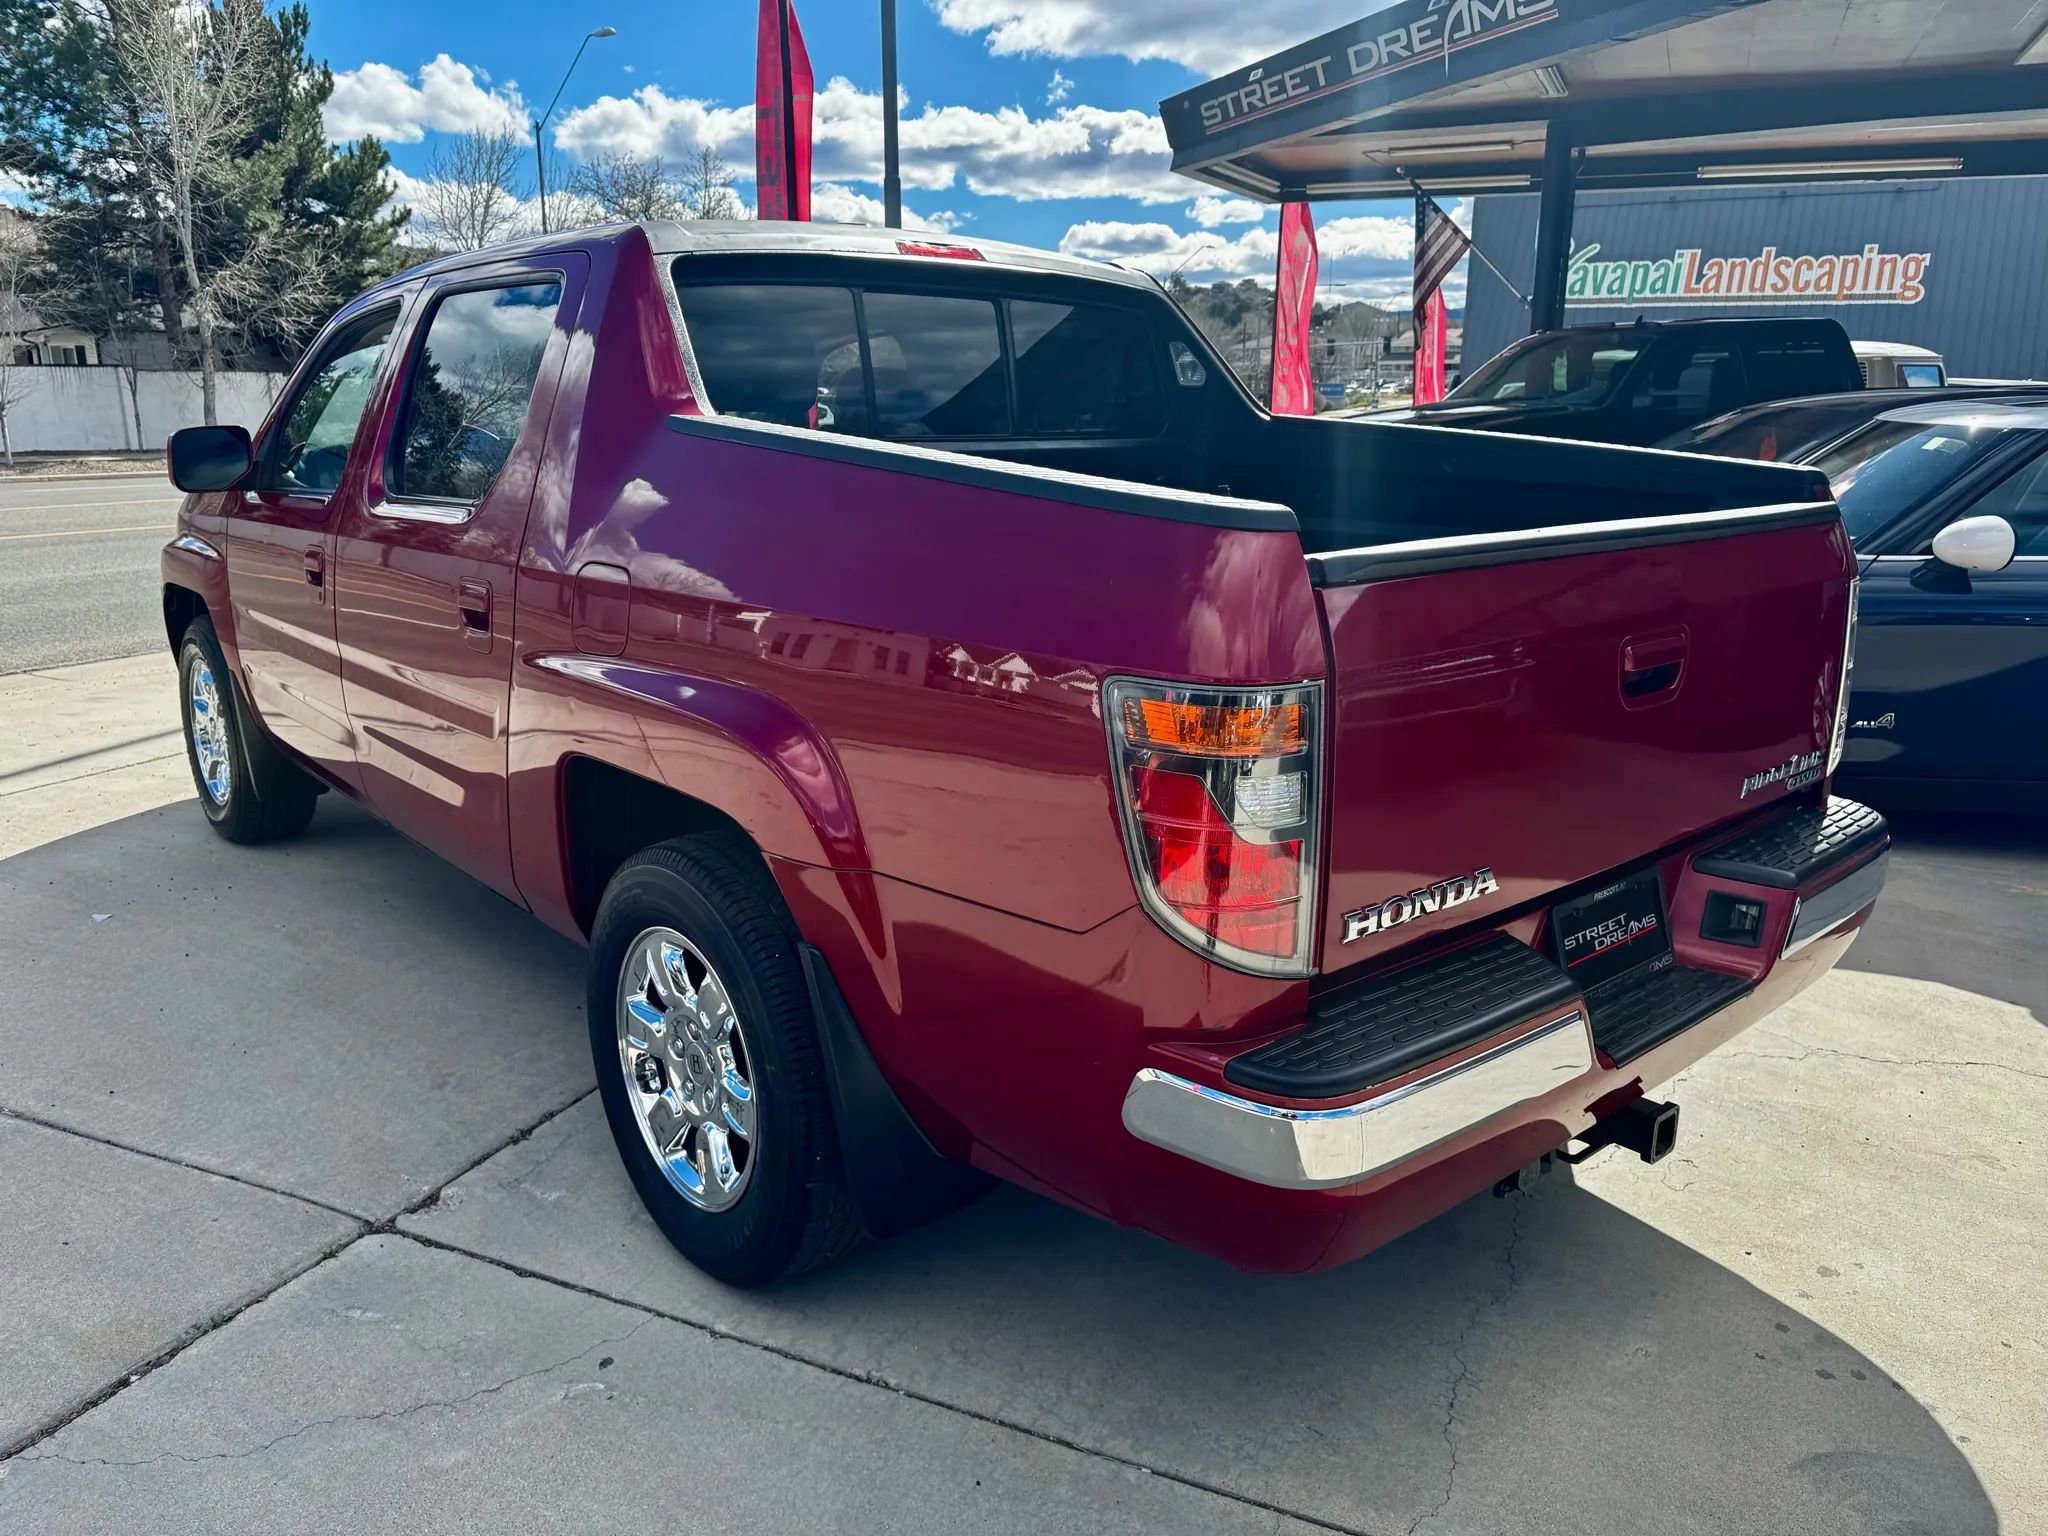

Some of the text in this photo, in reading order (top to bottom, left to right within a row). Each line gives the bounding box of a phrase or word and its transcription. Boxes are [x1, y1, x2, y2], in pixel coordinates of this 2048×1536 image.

[1200, 56, 1331, 127] STREET
[1682, 244, 1931, 304] Landscaping
[1342, 866, 1500, 945] HONDA
[1564, 912, 1628, 950] STREET
[1594, 913, 1657, 951] DREAMS
